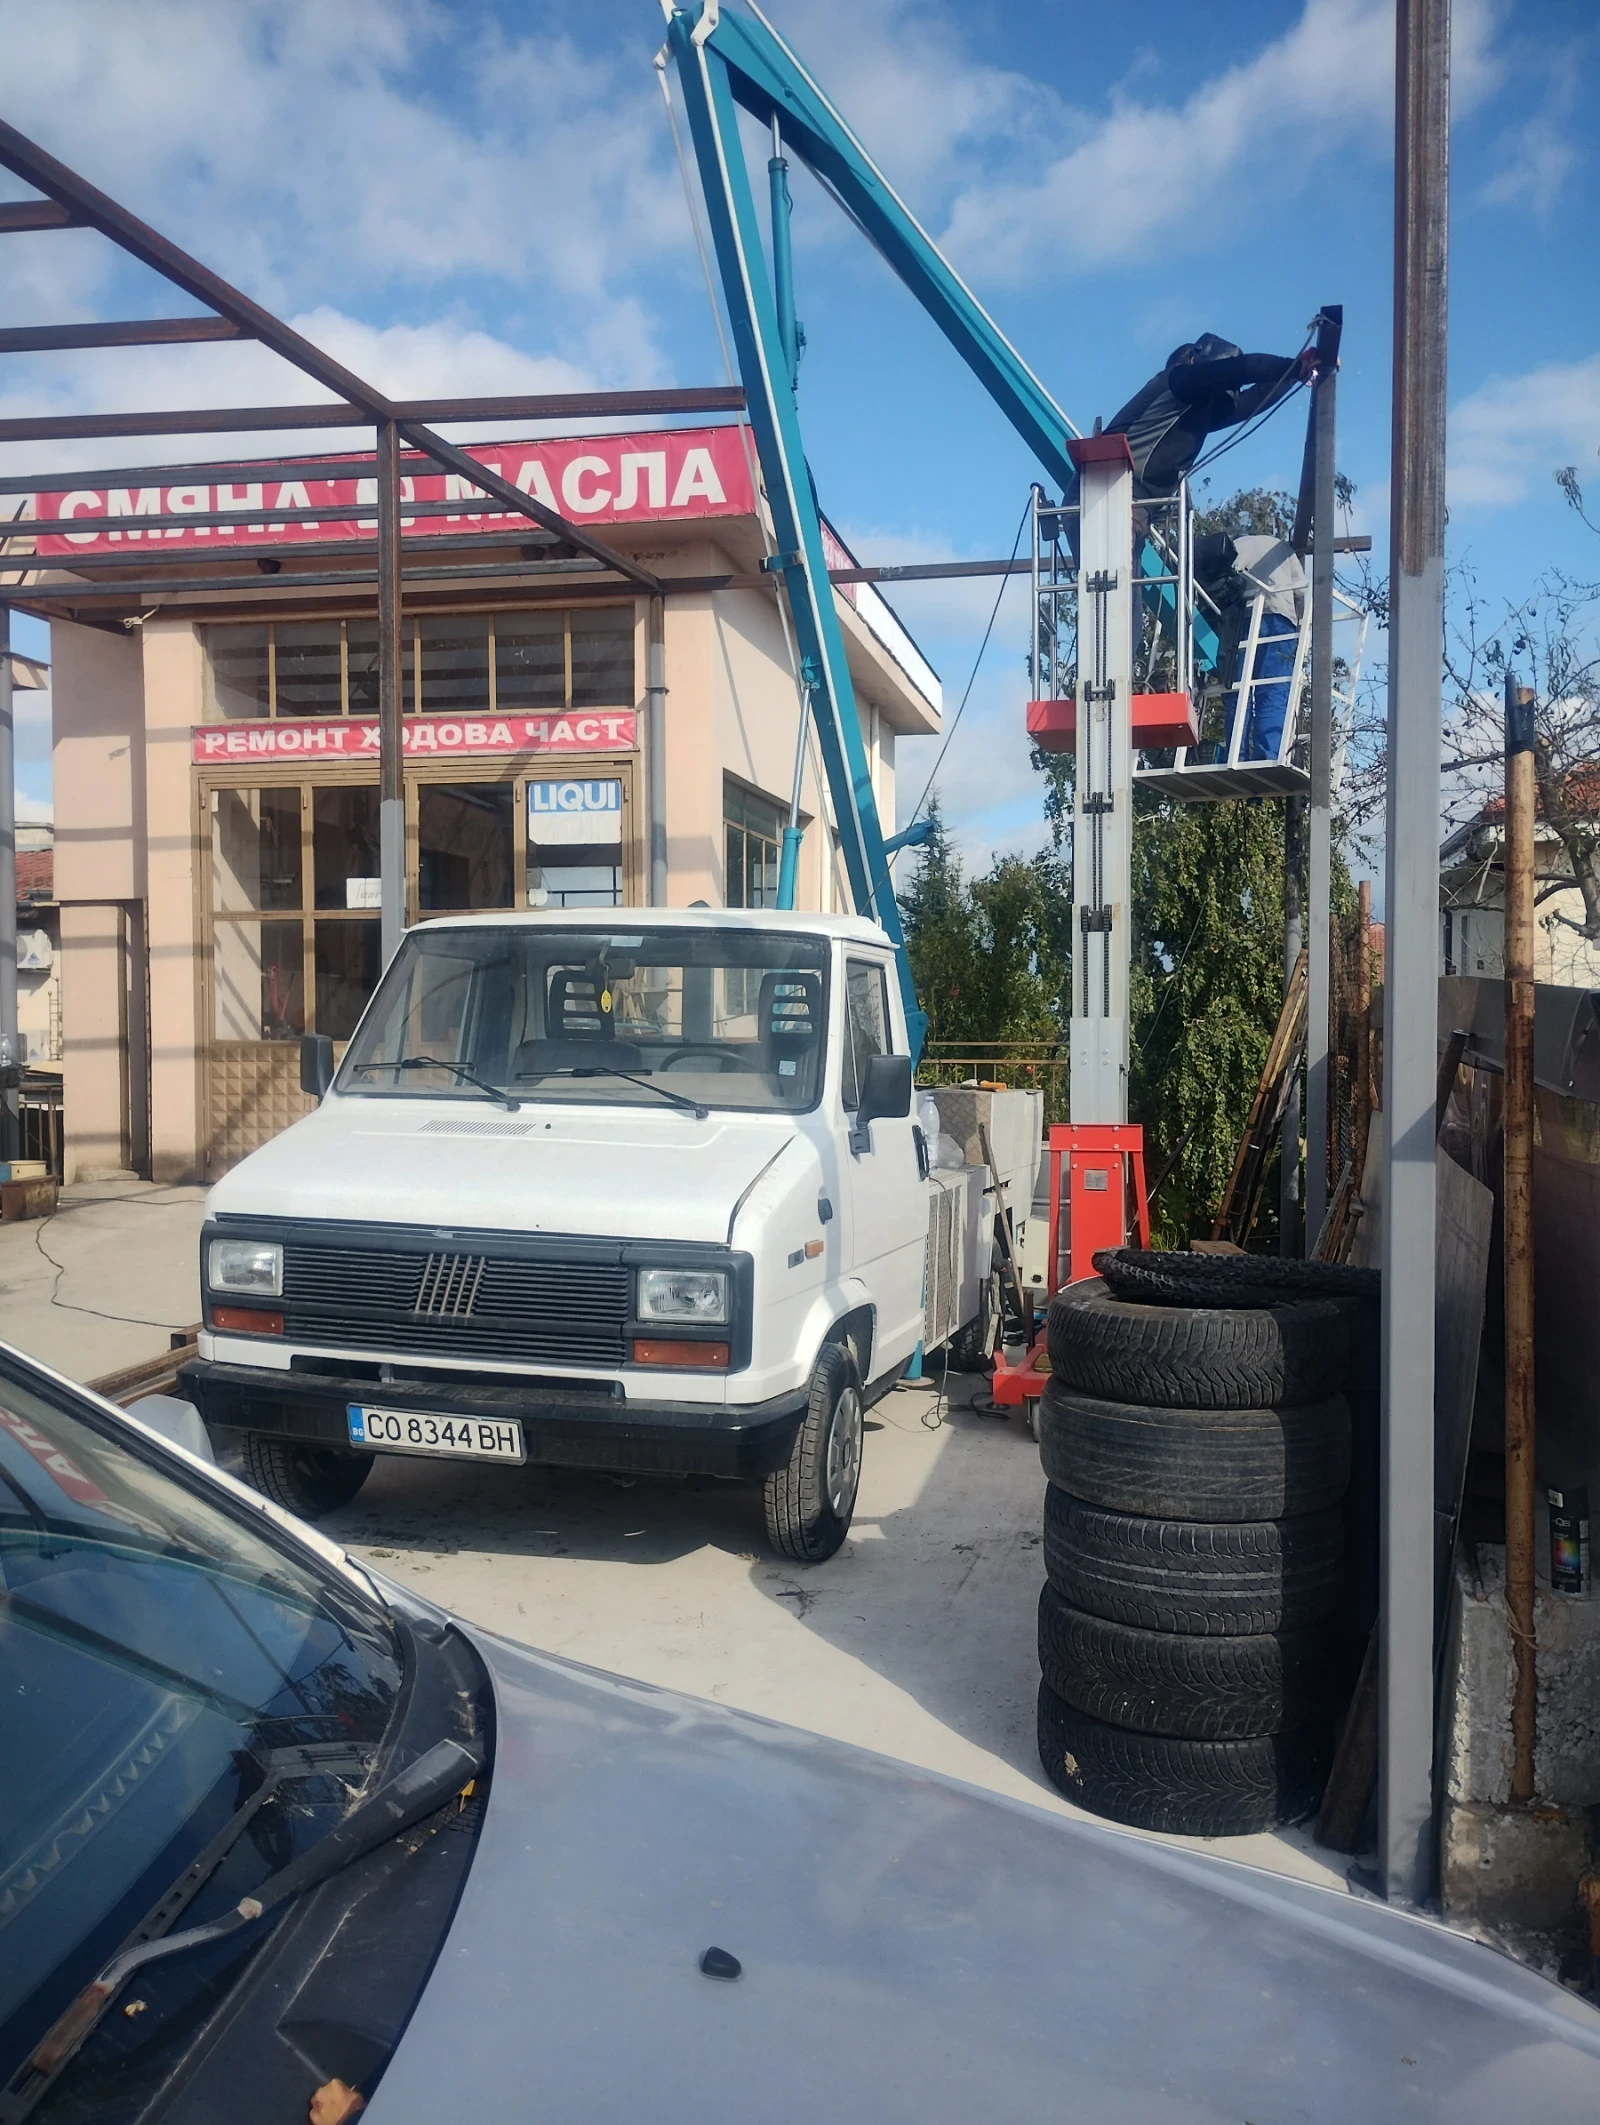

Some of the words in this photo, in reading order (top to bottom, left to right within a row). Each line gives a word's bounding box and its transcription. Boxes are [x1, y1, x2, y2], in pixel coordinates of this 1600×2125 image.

[445, 447, 728, 522] МАСЛА
[204, 727, 350, 754] РЕМОНТ
[525, 718, 625, 743] ЧАСТ
[533, 782, 616, 811] LIQUI
[352, 1427, 364, 1437] BG
[408, 1418, 473, 1448] 8344
[478, 1424, 514, 1452] BH
